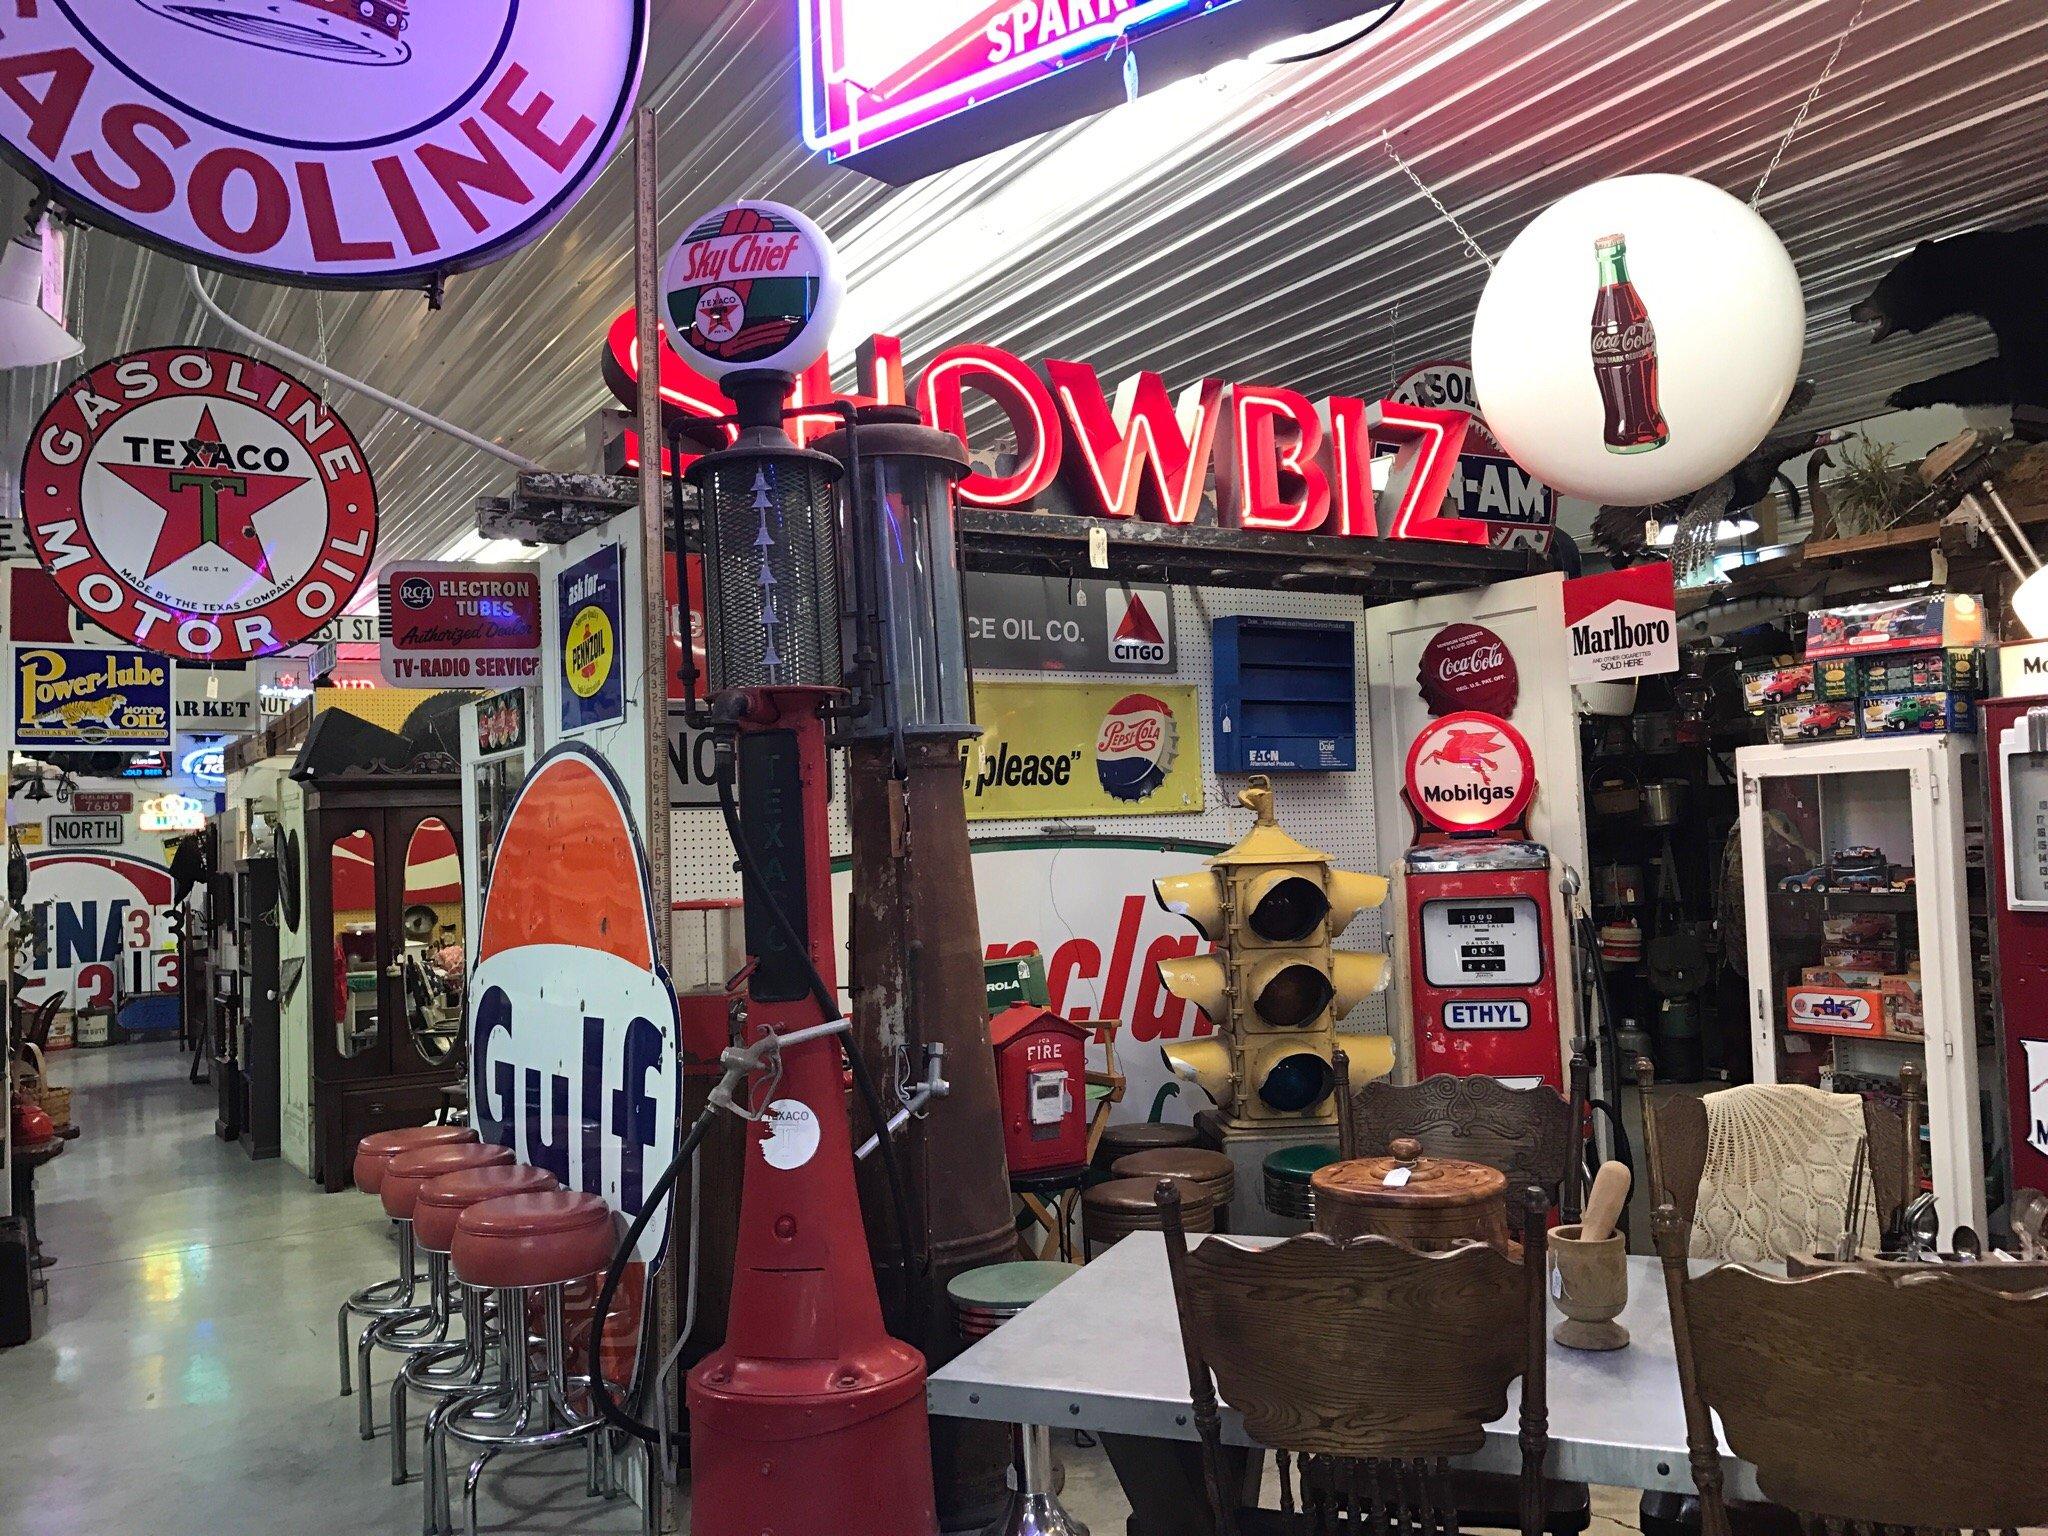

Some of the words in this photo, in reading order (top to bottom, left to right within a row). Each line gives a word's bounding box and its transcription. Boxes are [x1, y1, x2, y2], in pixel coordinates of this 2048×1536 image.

[0, 0, 597, 263] ASOLINE
[682, 240, 727, 281] Sky
[727, 233, 799, 273] Chief
[700, 296, 736, 308] TEXACO
[1592, 322, 1654, 355] Coca-Cola
[40, 354, 361, 482] GASOLINE
[122, 435, 290, 473] TEXACO
[168, 472, 248, 545] T
[294, 529, 370, 619] OIL
[36, 519, 279, 654] MOTOR
[120, 567, 153, 594] MADE
[155, 590, 173, 603] BY
[175, 597, 198, 611] THE
[202, 602, 241, 612] TEXAS
[245, 575, 296, 607] COMPANY
[401, 585, 433, 603] RCA
[439, 580, 530, 597] ELECTRON
[568, 583, 584, 606] ask
[456, 600, 514, 617] TUBES
[400, 622, 483, 646] Authorized
[1002, 617, 1041, 642] OIL
[1045, 619, 1085, 643] CO.
[1458, 631, 1484, 643] CONTENTS
[1572, 614, 1670, 657] Marlboro
[572, 629, 605, 675] PENNZOIL
[1114, 644, 1164, 661] CITGO
[1439, 641, 1505, 682] Coca-Cola
[1603, 655, 1621, 663] OTHER
[1621, 650, 1651, 660] CIGARETTES
[393, 656, 471, 678] TV-RADIO
[1600, 661, 1622, 672] SOLD
[1623, 657, 1644, 668] HERE
[120, 713, 167, 728] OIL
[123, 706, 166, 720] MOTOR
[144, 768, 163, 776] BEER
[1423, 782, 1516, 805] Mobilgas
[55, 821, 118, 840] NORTH
[127, 908, 152, 949] 3
[156, 953, 181, 993] 3
[986, 978, 1021, 992] ROLA
[1452, 1005, 1522, 1023] ETHYL
[1026, 1043, 1063, 1062] FIRE
[472, 983, 664, 1218] Gulf
